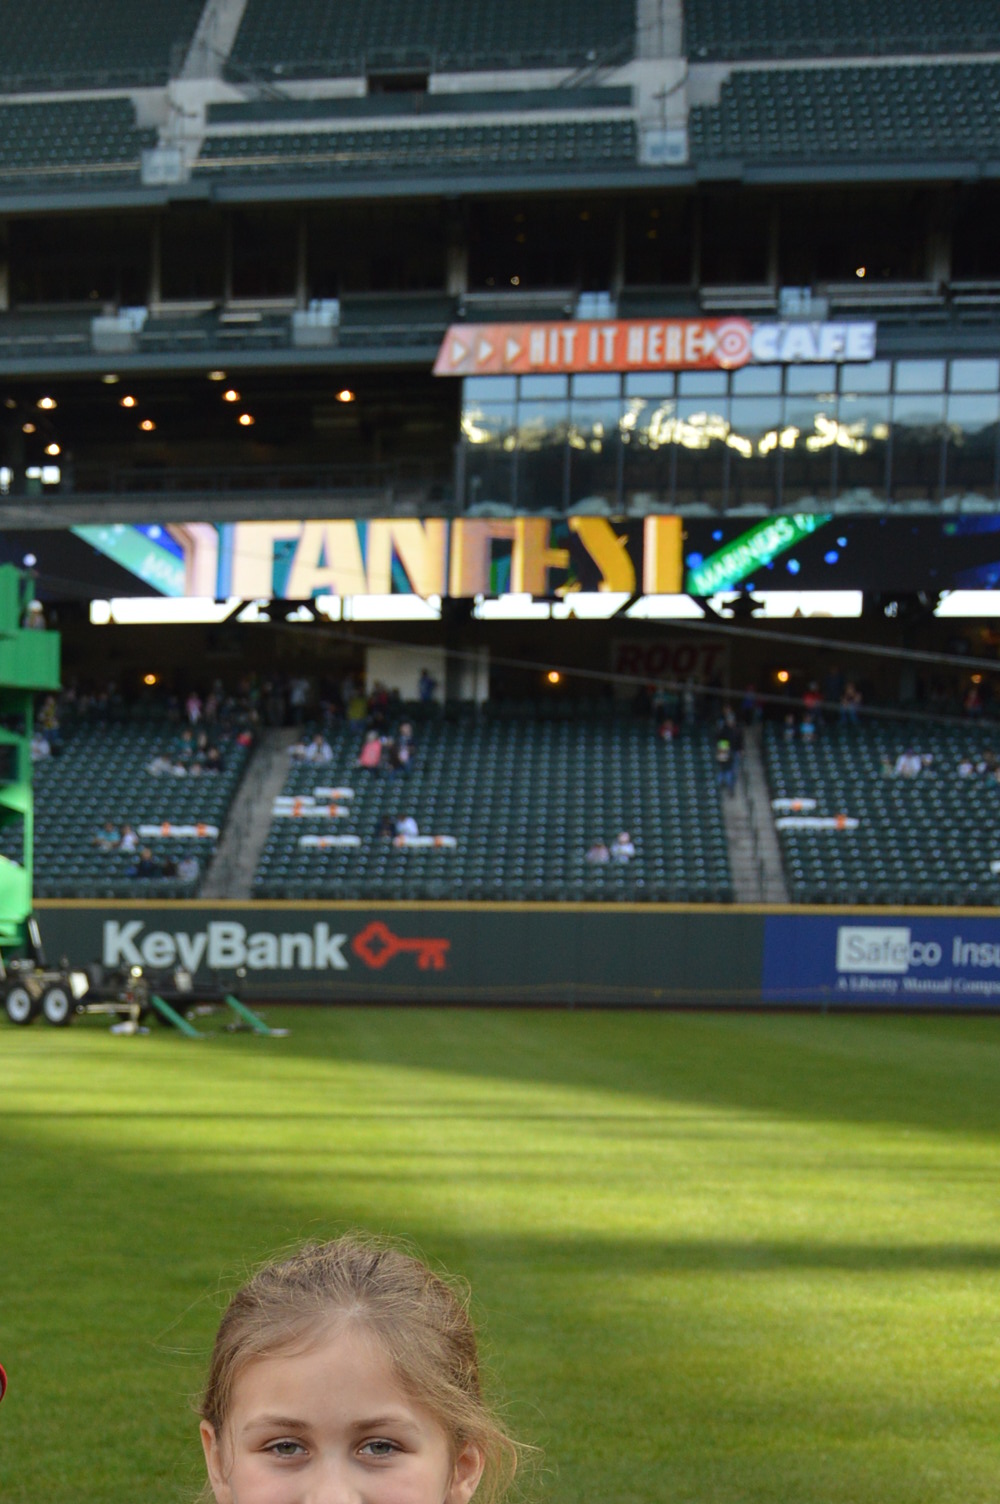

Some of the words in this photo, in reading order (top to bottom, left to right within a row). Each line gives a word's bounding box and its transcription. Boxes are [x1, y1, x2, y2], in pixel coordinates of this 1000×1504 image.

[529, 327, 577, 365] HIT
[588, 327, 618, 364] IT
[627, 324, 701, 364] HERE
[617, 643, 726, 676] ROOT
[103, 920, 349, 973] KeyBank
[846, 934, 943, 967] Safeco
